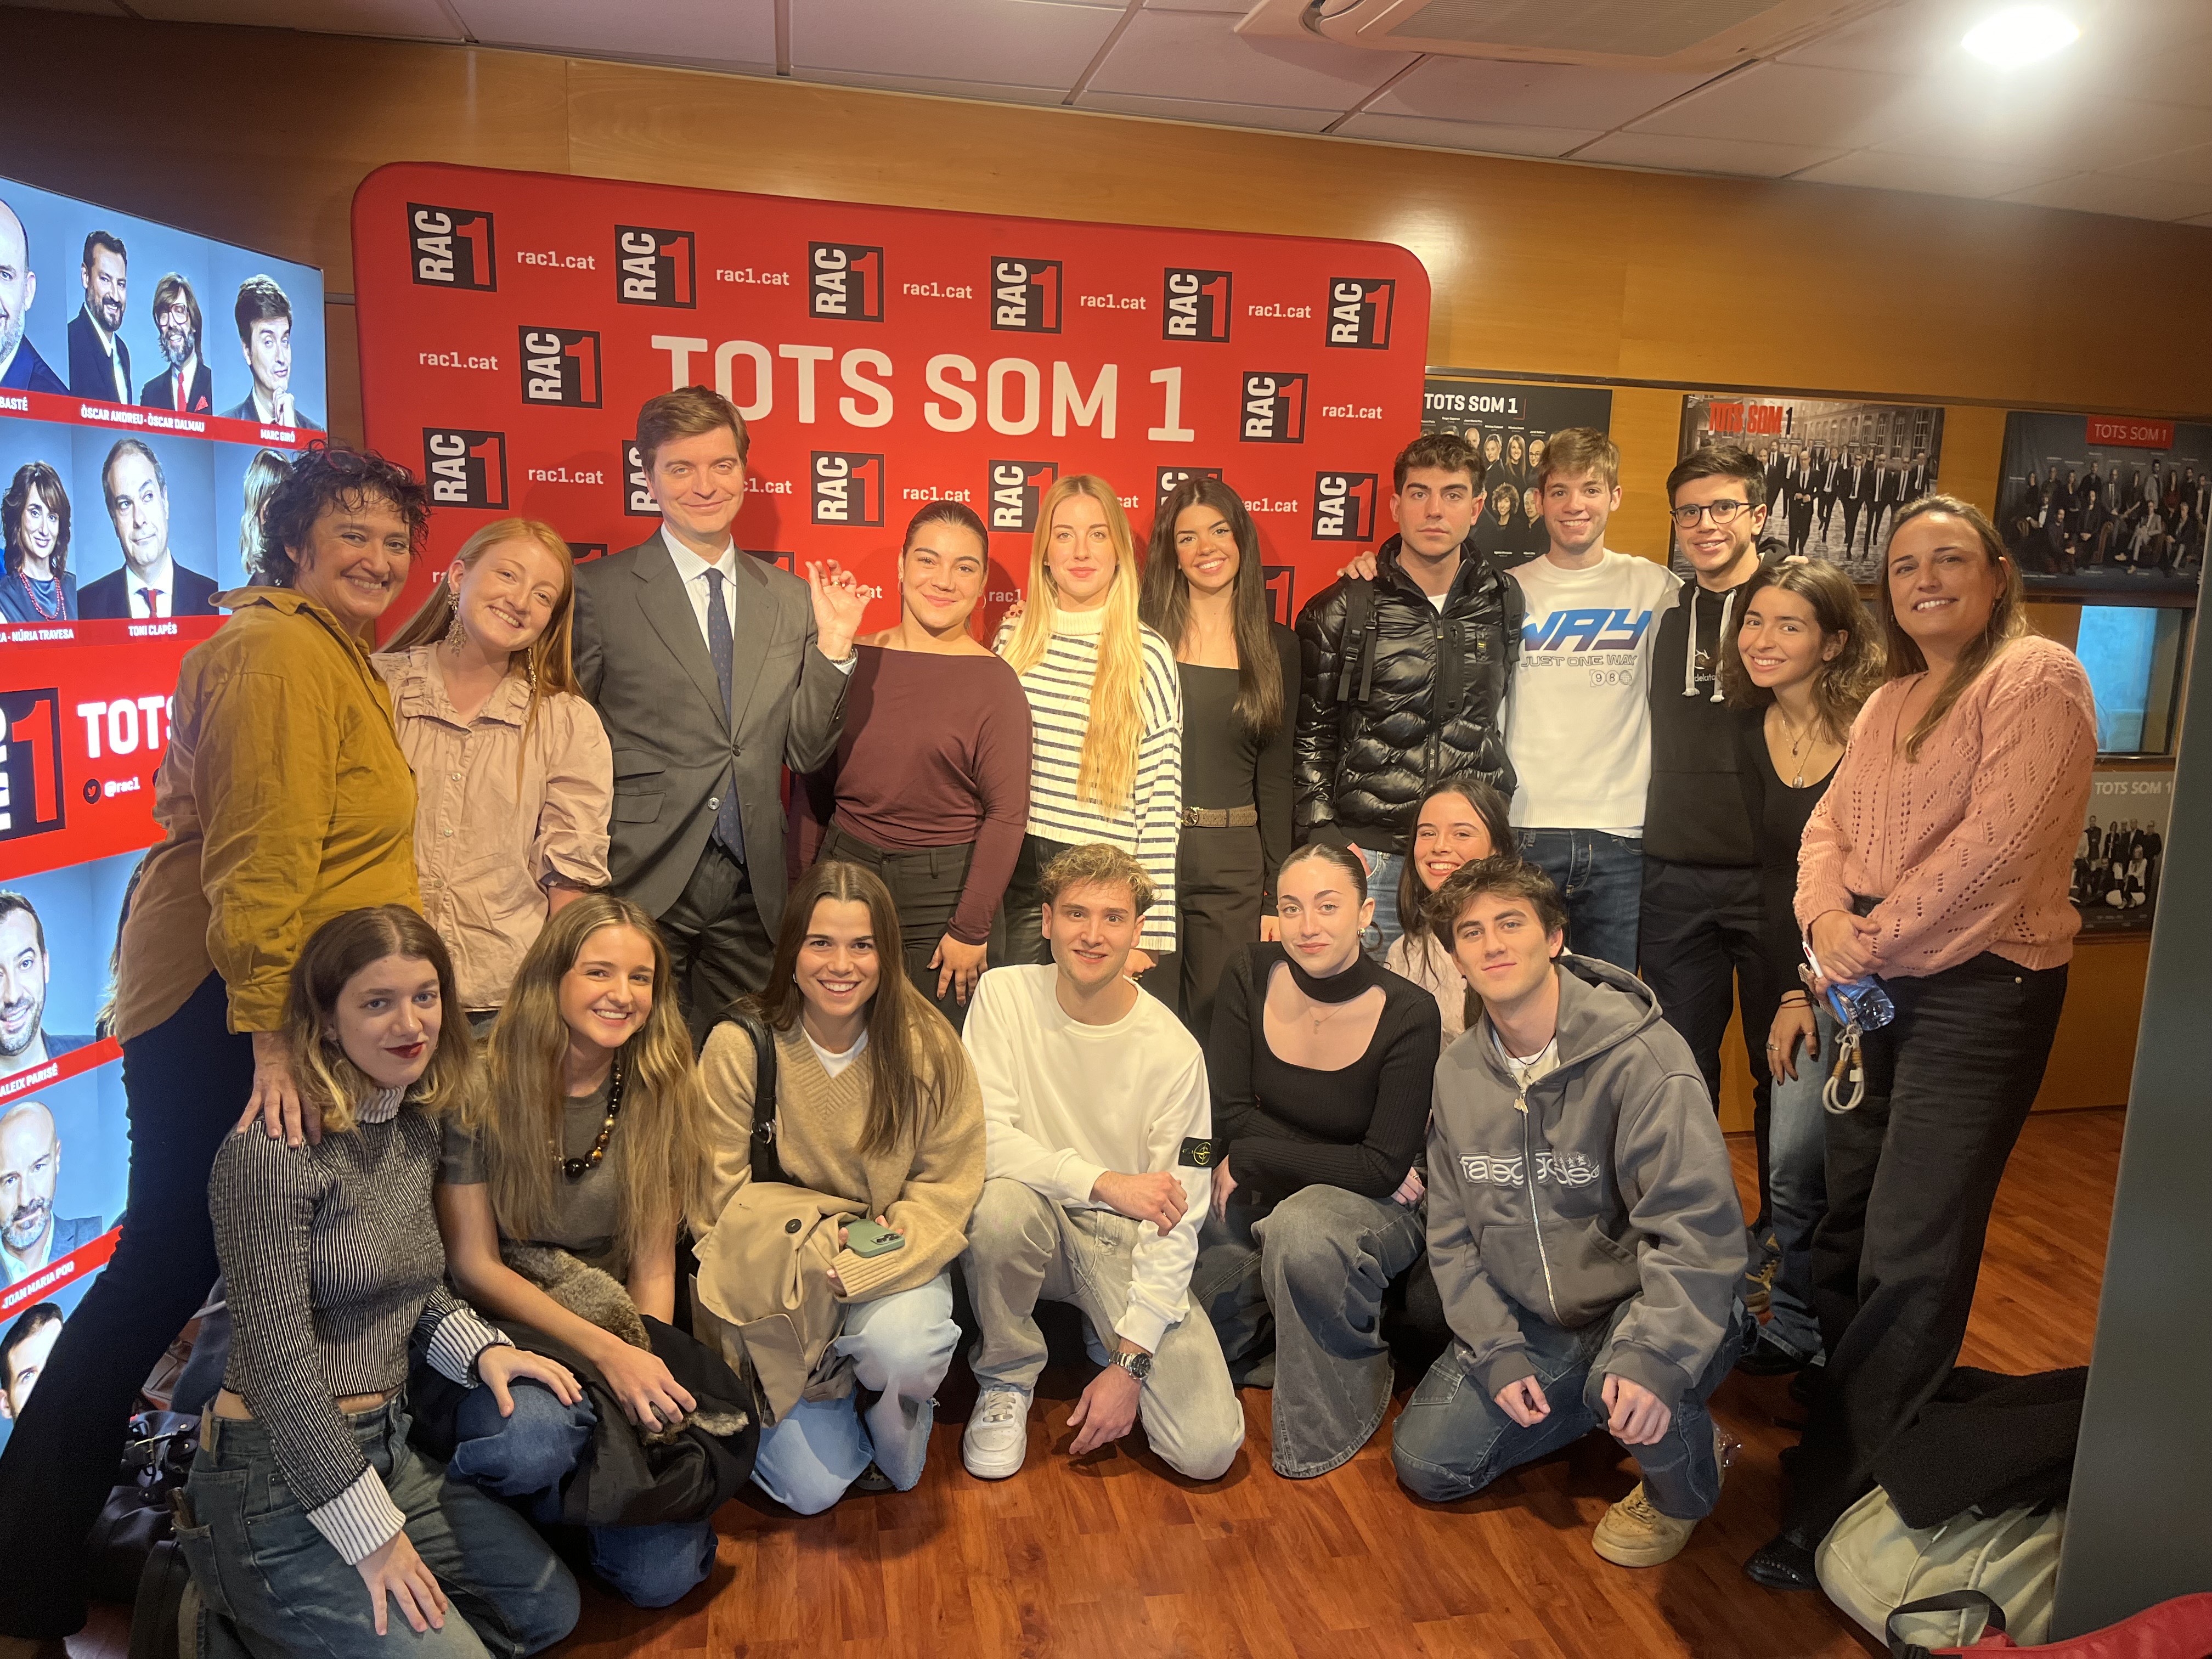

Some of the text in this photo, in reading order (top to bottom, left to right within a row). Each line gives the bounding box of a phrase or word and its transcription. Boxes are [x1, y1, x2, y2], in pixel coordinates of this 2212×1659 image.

[415, 211, 490, 285] RAC 1
[517, 251, 596, 270] rac1.cat
[621, 232, 691, 303] RAC 1
[716, 268, 789, 286] rac1.cat
[814, 248, 878, 317] RAC 1
[903, 282, 972, 299] rac1.cat
[996, 263, 1058, 328] RAC 1
[1080, 294, 1146, 310] rac1.cat
[1168, 274, 1227, 337] RAC 1
[1248, 303, 1311, 319] rac1.cat
[1331, 283, 1390, 344] RAC 1
[419, 352, 498, 370] rac1.cat
[526, 332, 596, 403] RAC 1
[651, 335, 1194, 442] TOTS SOM 1
[1245, 377, 1303, 438] RAC 1
[1322, 404, 1383, 419] rac1.cat
[1424, 393, 1518, 414] TOTS SOM 1
[110, 410, 143, 425] ANDREU
[174, 418, 205, 432] DALMAU
[1709, 402, 1793, 435] TOTS SOM 1
[2095, 424, 2126, 439] TOTS
[2130, 426, 2159, 442] SOM
[430, 435, 502, 504] RAC 1
[528, 467, 603, 484] rac1.cat
[816, 456, 879, 522] RAC 1
[903, 486, 970, 503] rac1.cat
[994, 465, 1024, 527] RAC
[1242, 498, 1298, 513] ac1.cat
[1317, 477, 1373, 537] RAC 1
[12, 629, 38, 642] NÚRIA
[38, 629, 74, 640] TRAVESA
[128, 622, 178, 636] TONI CLAPÉS
[1521, 654, 1638, 667] JUST ONE WAY
[104, 776, 140, 797] @rac1
[2095, 781, 2128, 795] TOTS
[2131, 781, 2162, 795] SOM
[0, 1077, 26, 1097] ALEIX
[2, 1261, 74, 1309] JOAN MARIA POU
